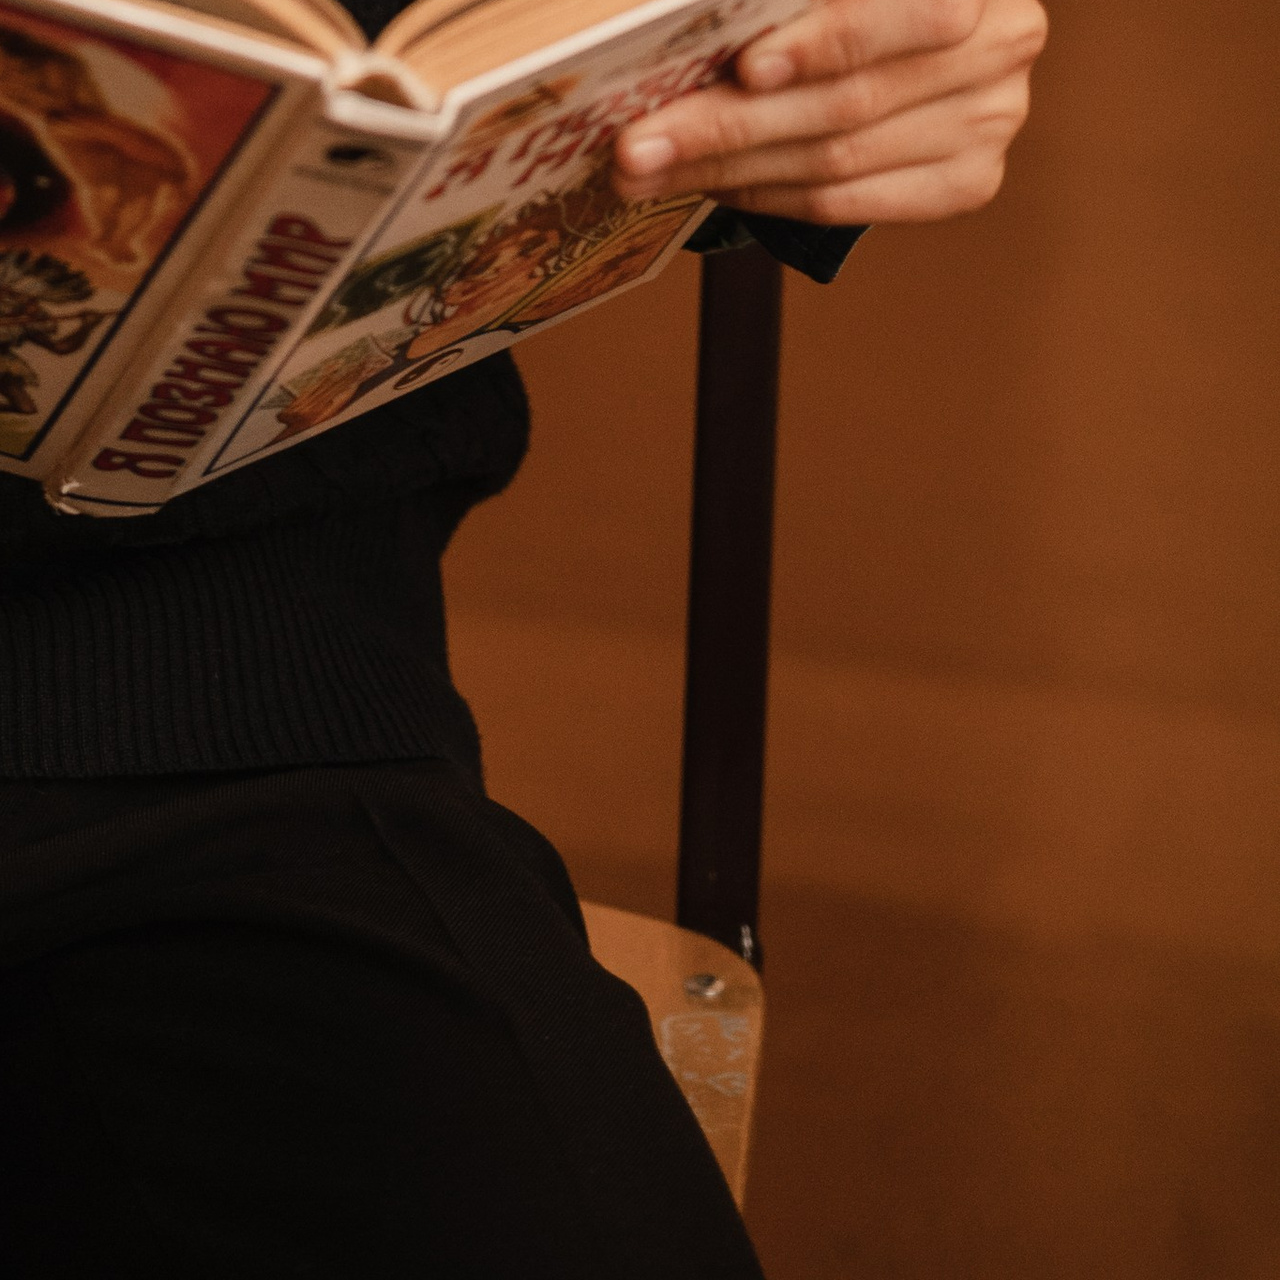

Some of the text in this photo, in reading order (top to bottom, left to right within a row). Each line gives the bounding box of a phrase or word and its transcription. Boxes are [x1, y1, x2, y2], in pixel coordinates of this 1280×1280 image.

[230, 210, 354, 307] МИР
[120, 303, 290, 448] ПОЗНАЮ
[90, 446, 187, 480] Я
